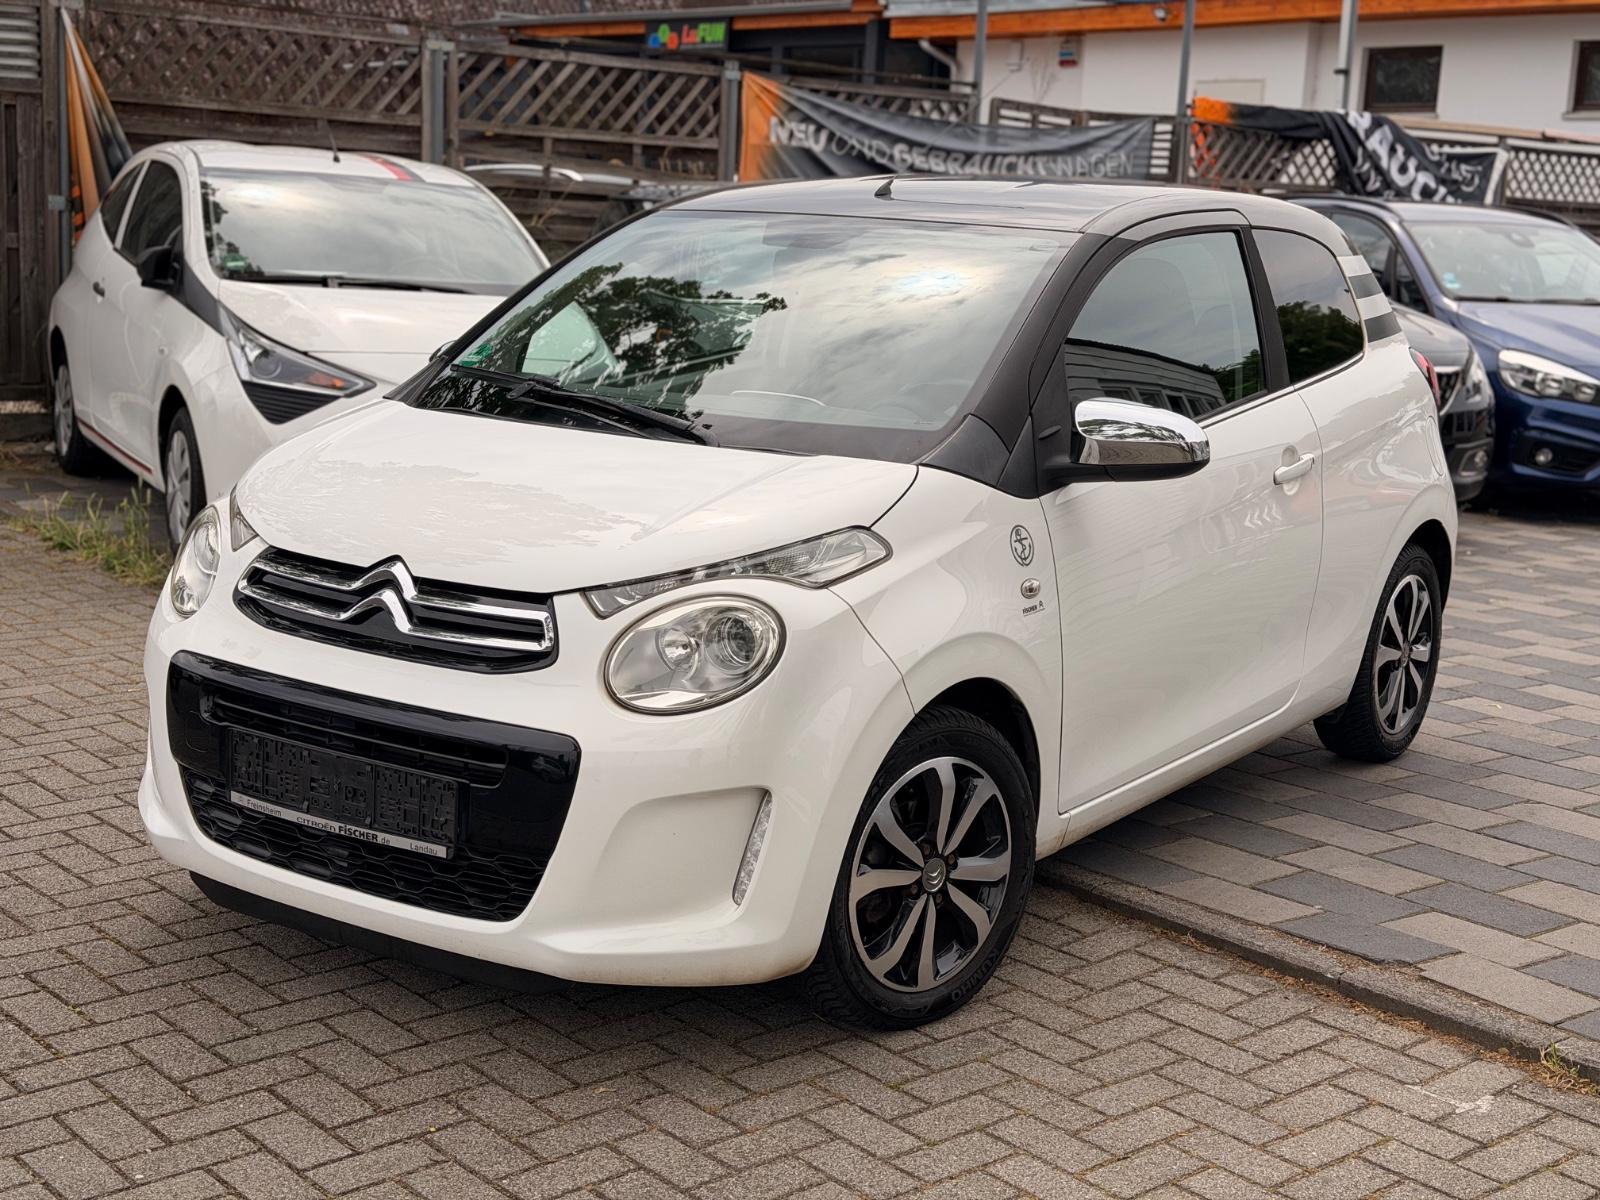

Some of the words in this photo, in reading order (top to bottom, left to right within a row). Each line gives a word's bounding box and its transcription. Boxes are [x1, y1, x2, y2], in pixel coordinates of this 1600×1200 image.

[769, 115, 829, 152] NEU
[246, 799, 282, 817] Freinsheim
[409, 842, 438, 854] Landau
